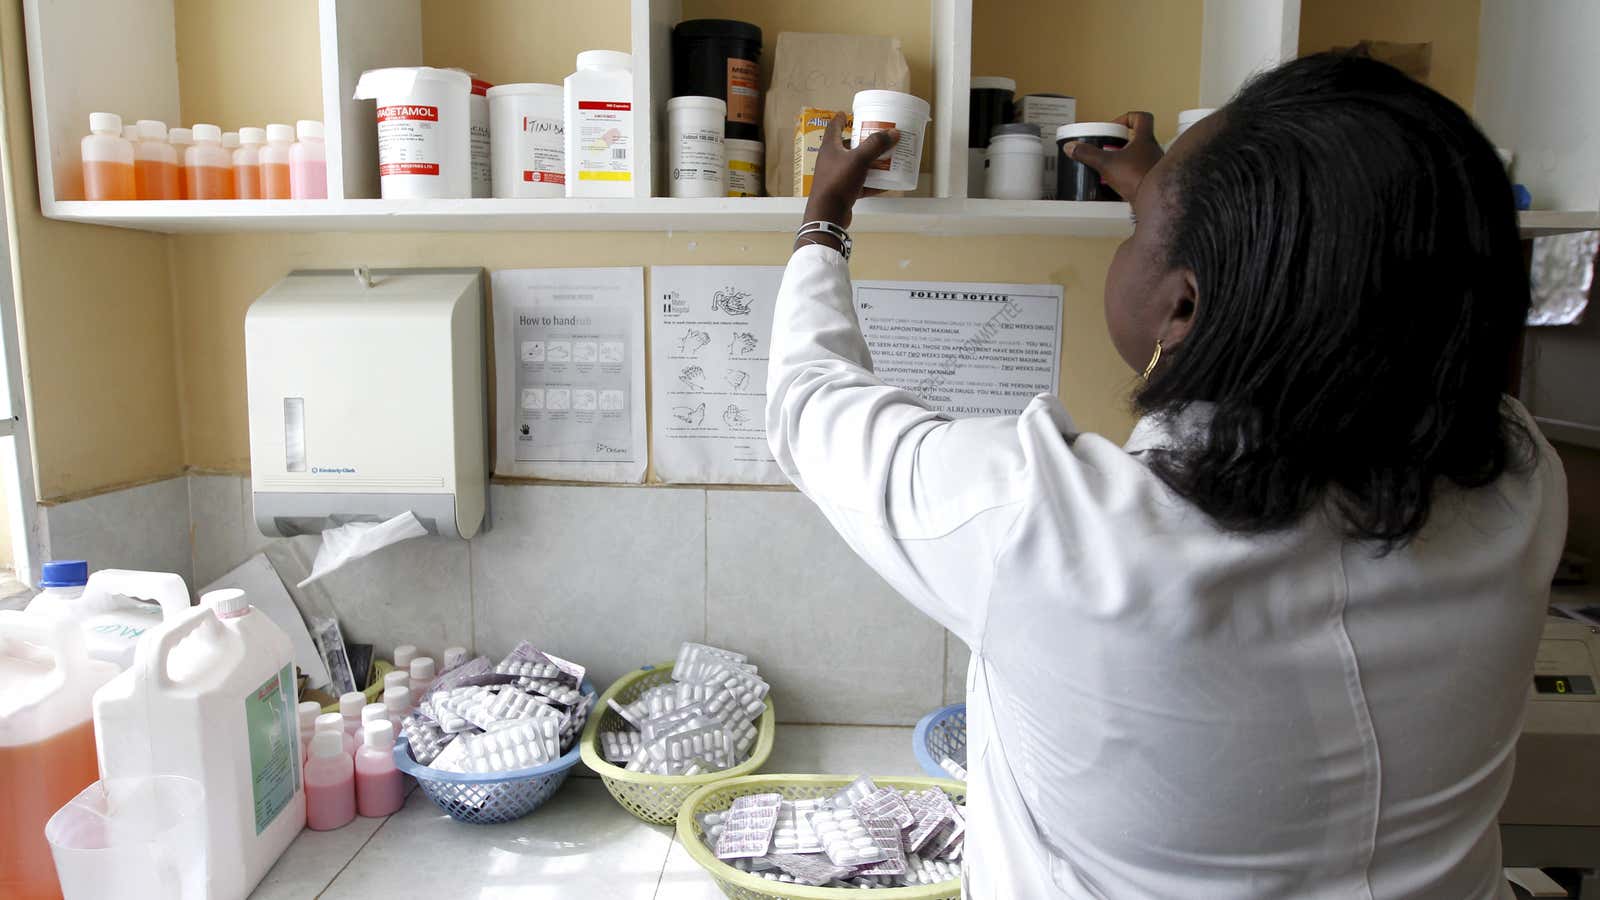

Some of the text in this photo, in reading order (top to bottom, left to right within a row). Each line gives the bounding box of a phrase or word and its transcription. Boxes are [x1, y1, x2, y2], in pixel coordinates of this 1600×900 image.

[807, 117, 829, 127] Albu
[910, 290, 1009, 302] POLITE NOTICE
[519, 315, 539, 326] How
[542, 316, 552, 326] to
[946, 405, 982, 414] ALREADY
